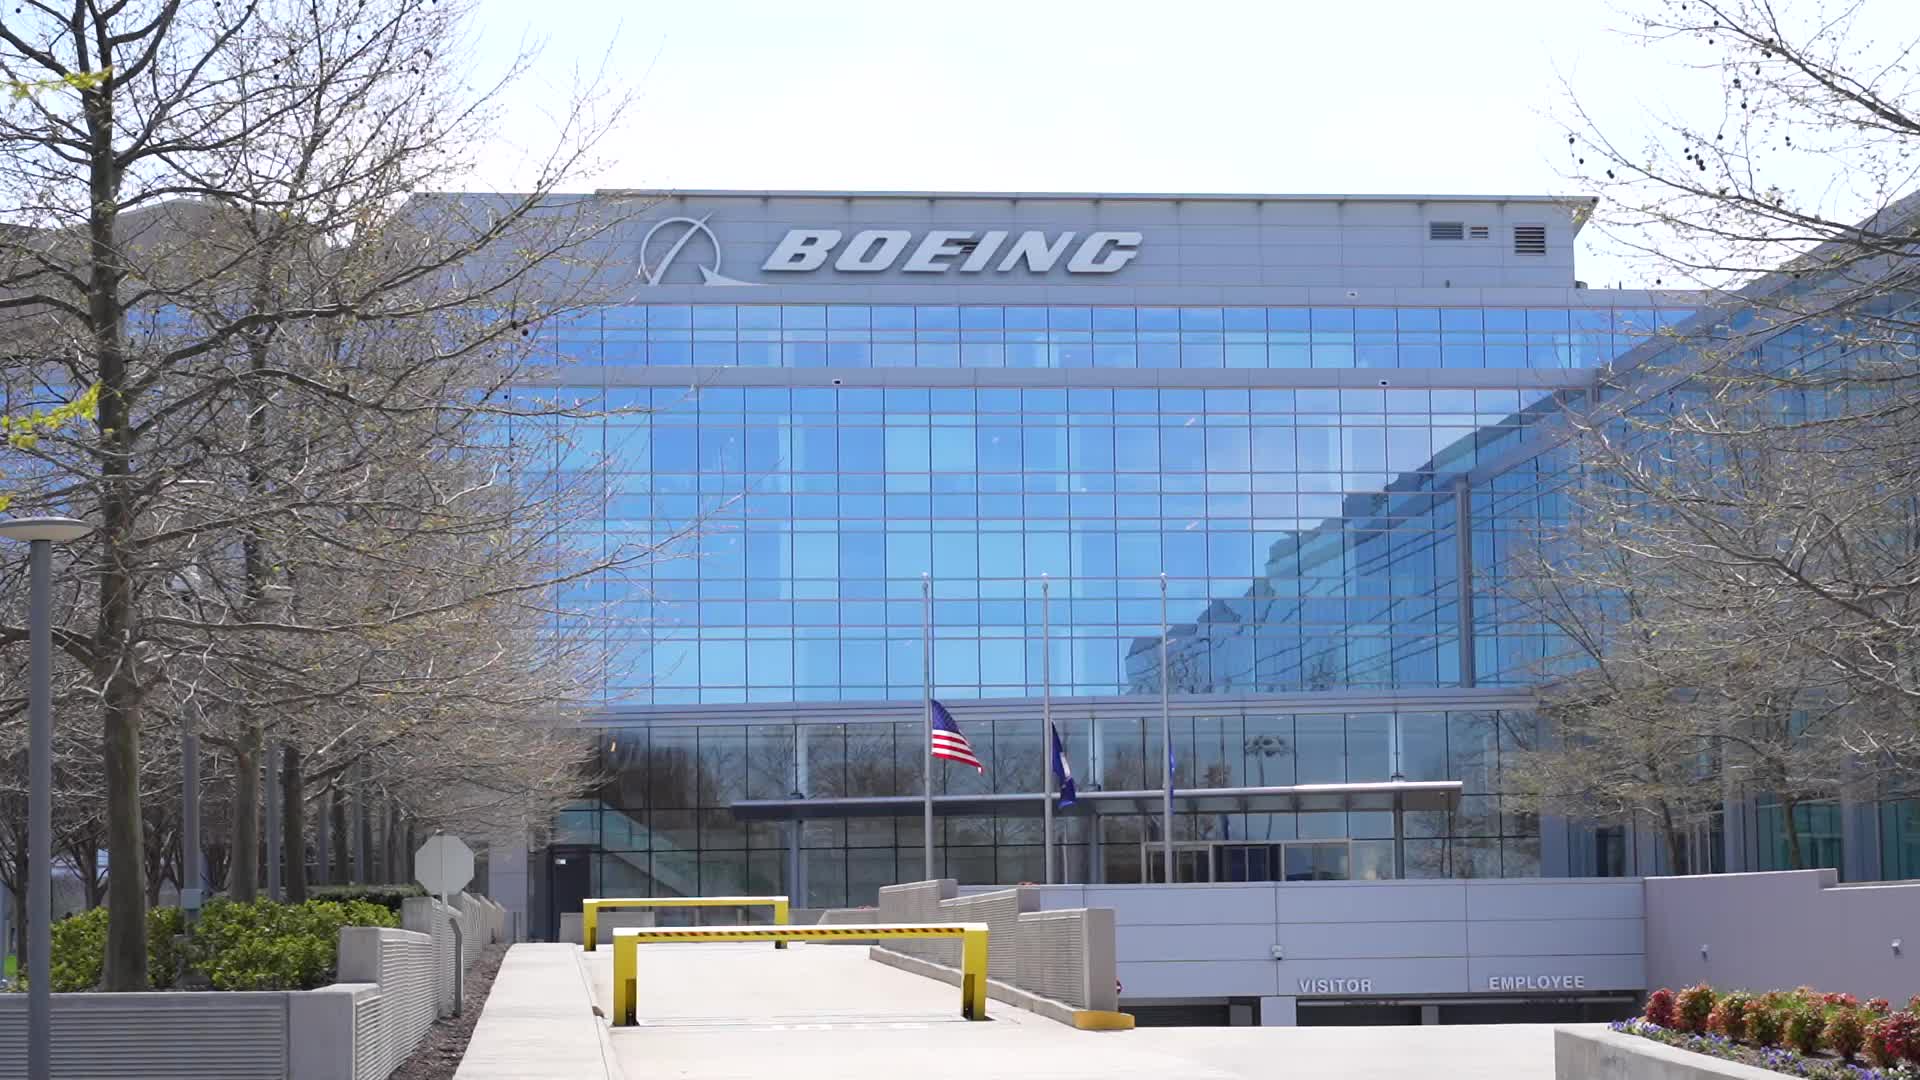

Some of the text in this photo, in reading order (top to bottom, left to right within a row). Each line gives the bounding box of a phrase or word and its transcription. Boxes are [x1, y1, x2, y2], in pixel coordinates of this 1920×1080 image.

[761, 229, 1143, 272] BOEING
[1299, 978, 1373, 993] VISITOR
[1488, 975, 1585, 990] EMPLOYEE
